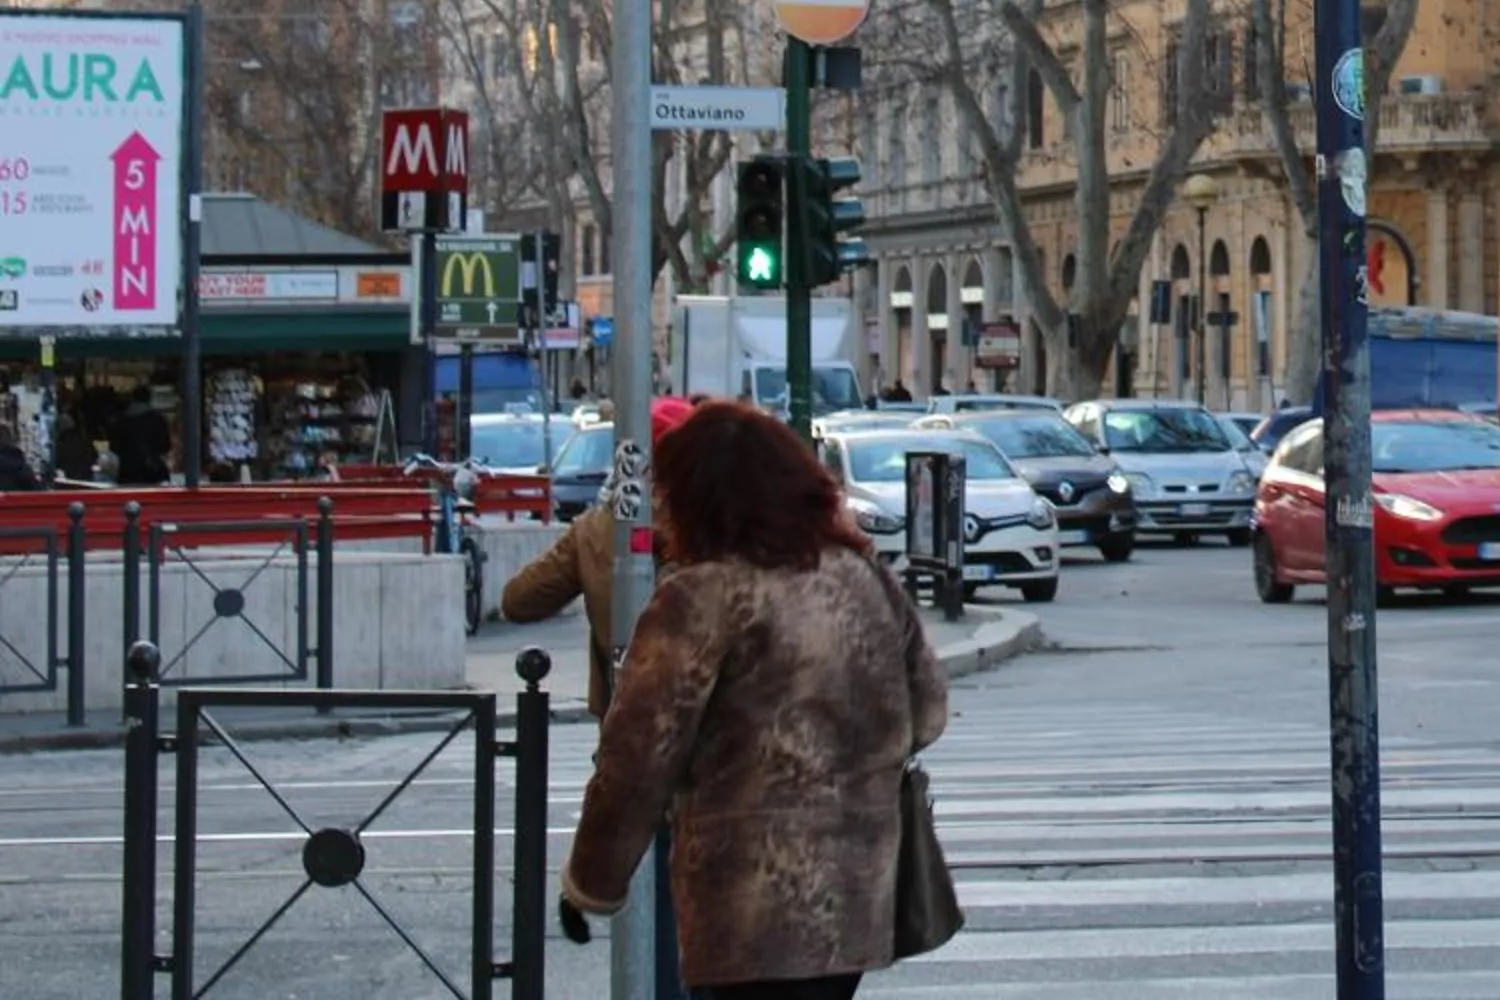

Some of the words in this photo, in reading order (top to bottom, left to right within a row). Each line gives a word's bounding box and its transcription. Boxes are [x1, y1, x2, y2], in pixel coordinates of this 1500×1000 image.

[0, 53, 165, 102] AURA
[655, 103, 745, 120] Ottaviano
[387, 123, 438, 176] M
[445, 123, 465, 176] M
[0, 157, 28, 181] 60
[124, 160, 145, 189] 5
[2, 190, 27, 215] 15
